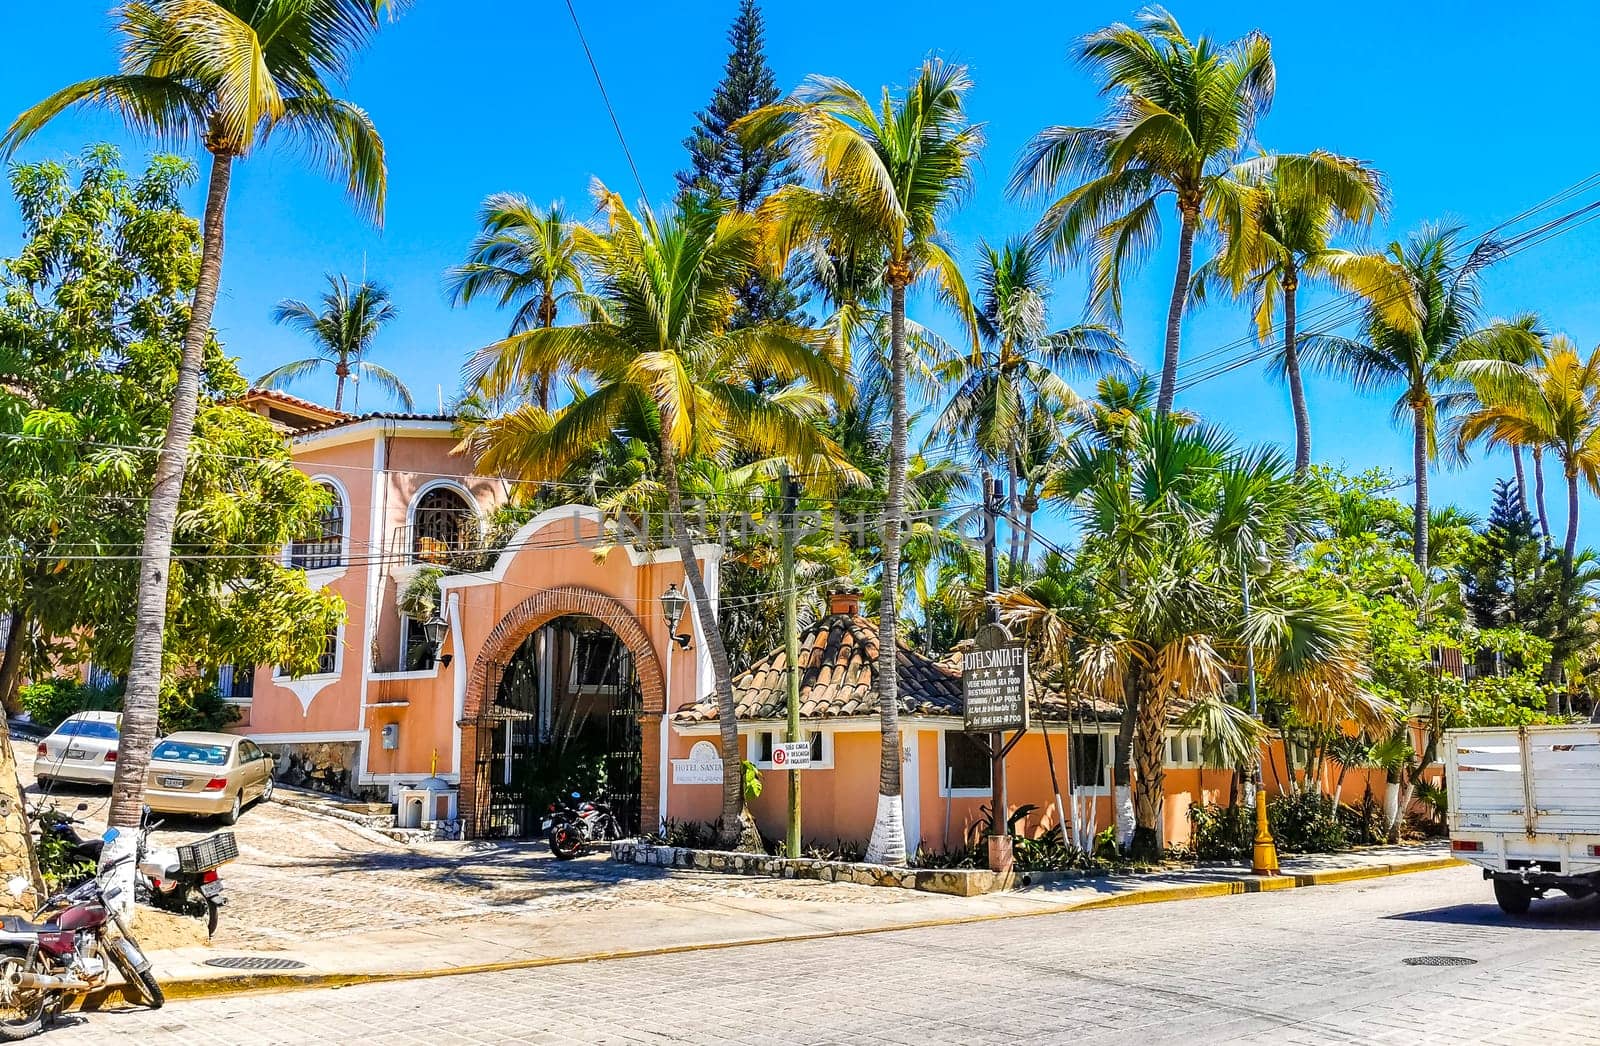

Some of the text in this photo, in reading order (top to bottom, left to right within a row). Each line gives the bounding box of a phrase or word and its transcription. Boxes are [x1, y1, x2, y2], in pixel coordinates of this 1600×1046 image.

[961, 647, 1023, 671] HOTEL SANTA FE
[1007, 677, 1021, 685] FOOD
[968, 686, 1020, 696] RESTAURANT BAR
[1004, 694, 1022, 702] POOLS
[675, 763, 722, 772] HOTEL SANTA
